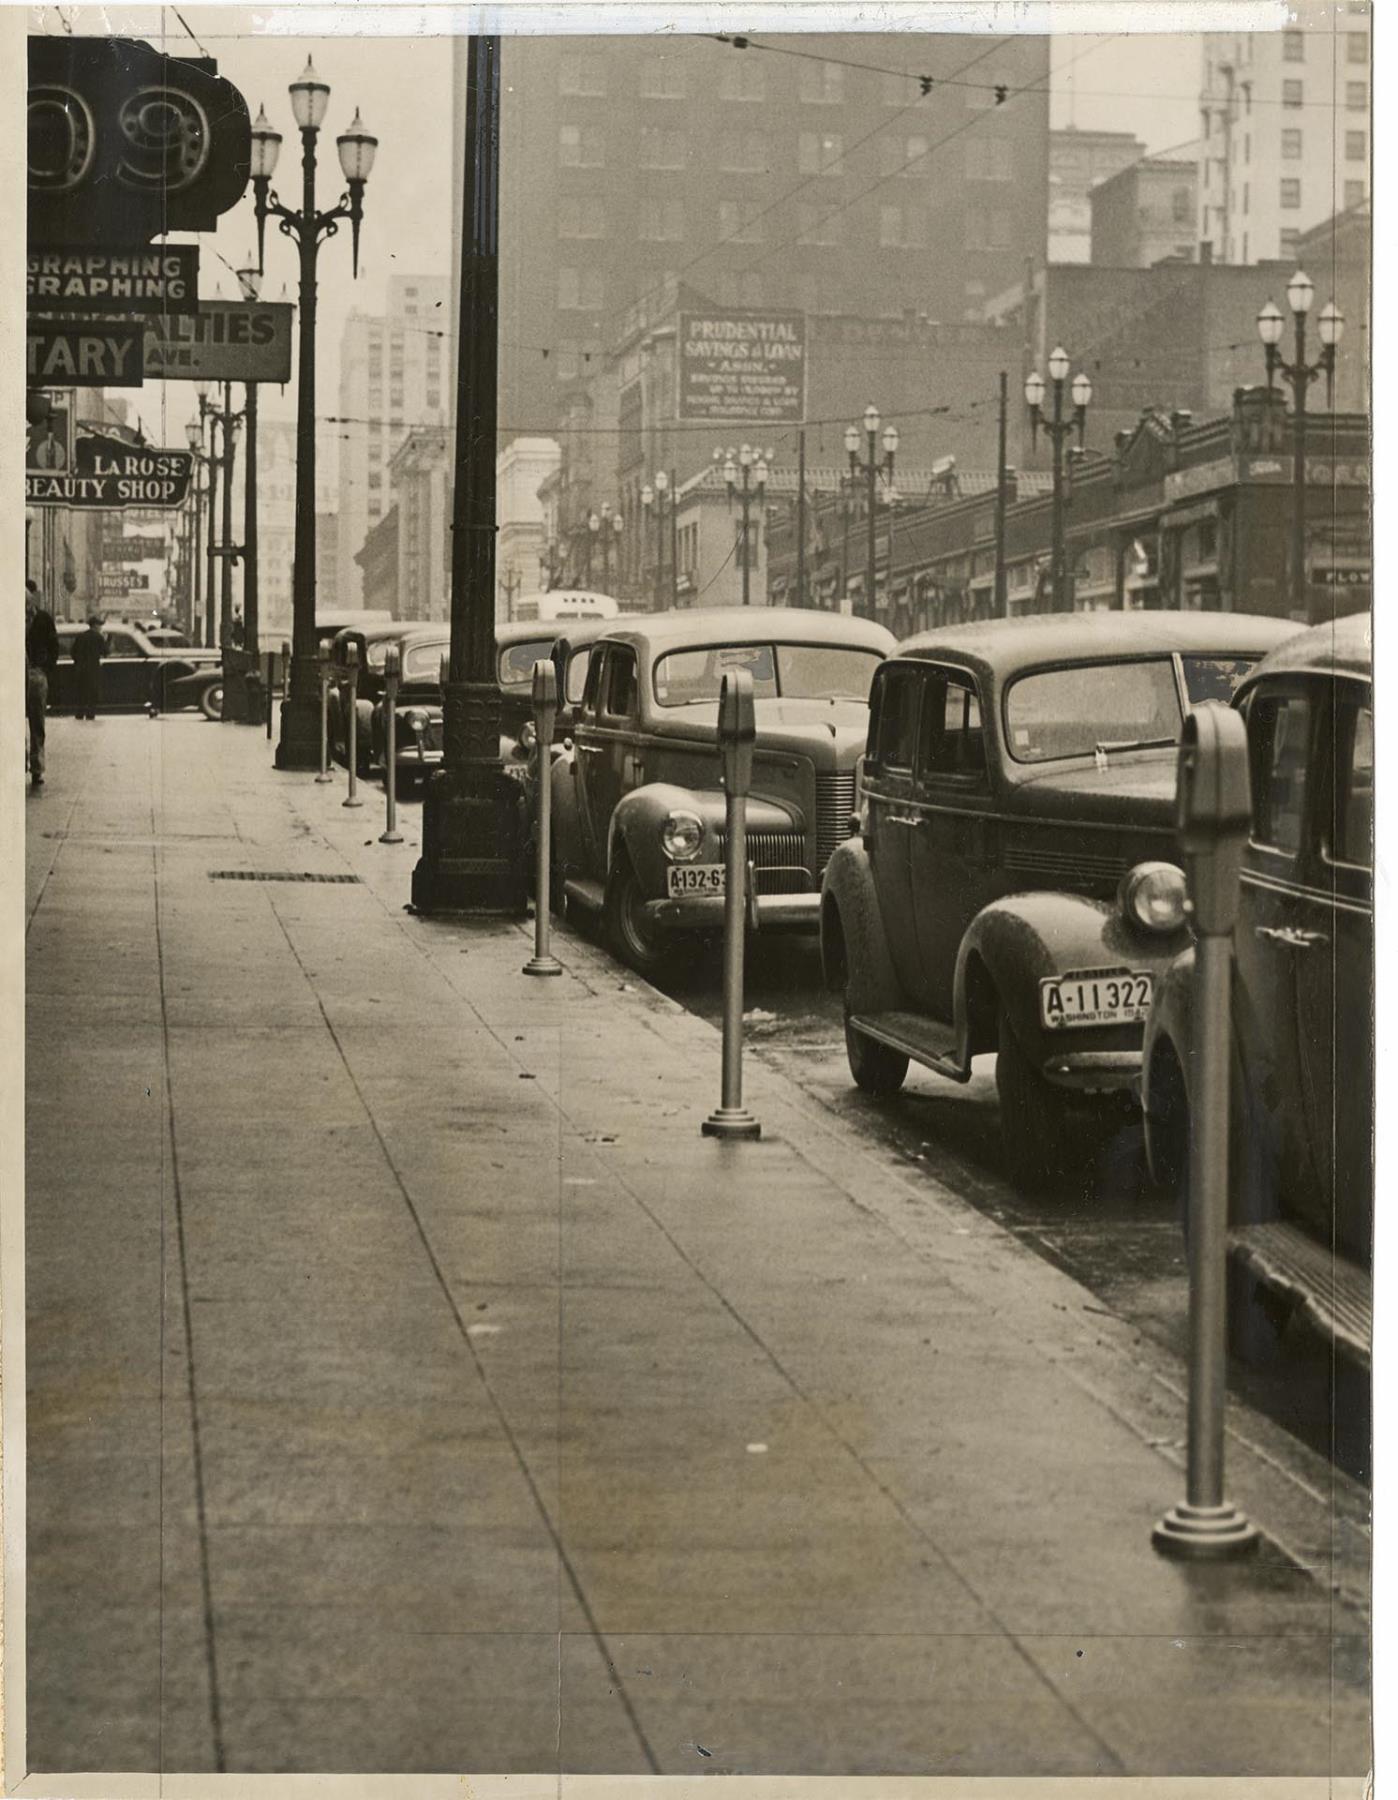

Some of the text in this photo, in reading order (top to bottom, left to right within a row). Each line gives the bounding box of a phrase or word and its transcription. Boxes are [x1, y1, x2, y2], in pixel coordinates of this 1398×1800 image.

[690, 321, 797, 341] PRUDENTIAL
[27, 335, 133, 376] TARY
[685, 340, 749, 358] SAVINGS
[764, 343, 802, 360] LOAN
[117, 479, 175, 499] SHOP
[1047, 980, 1150, 1013] A-11322
[1050, 1011, 1118, 1022] WASHINGTON
